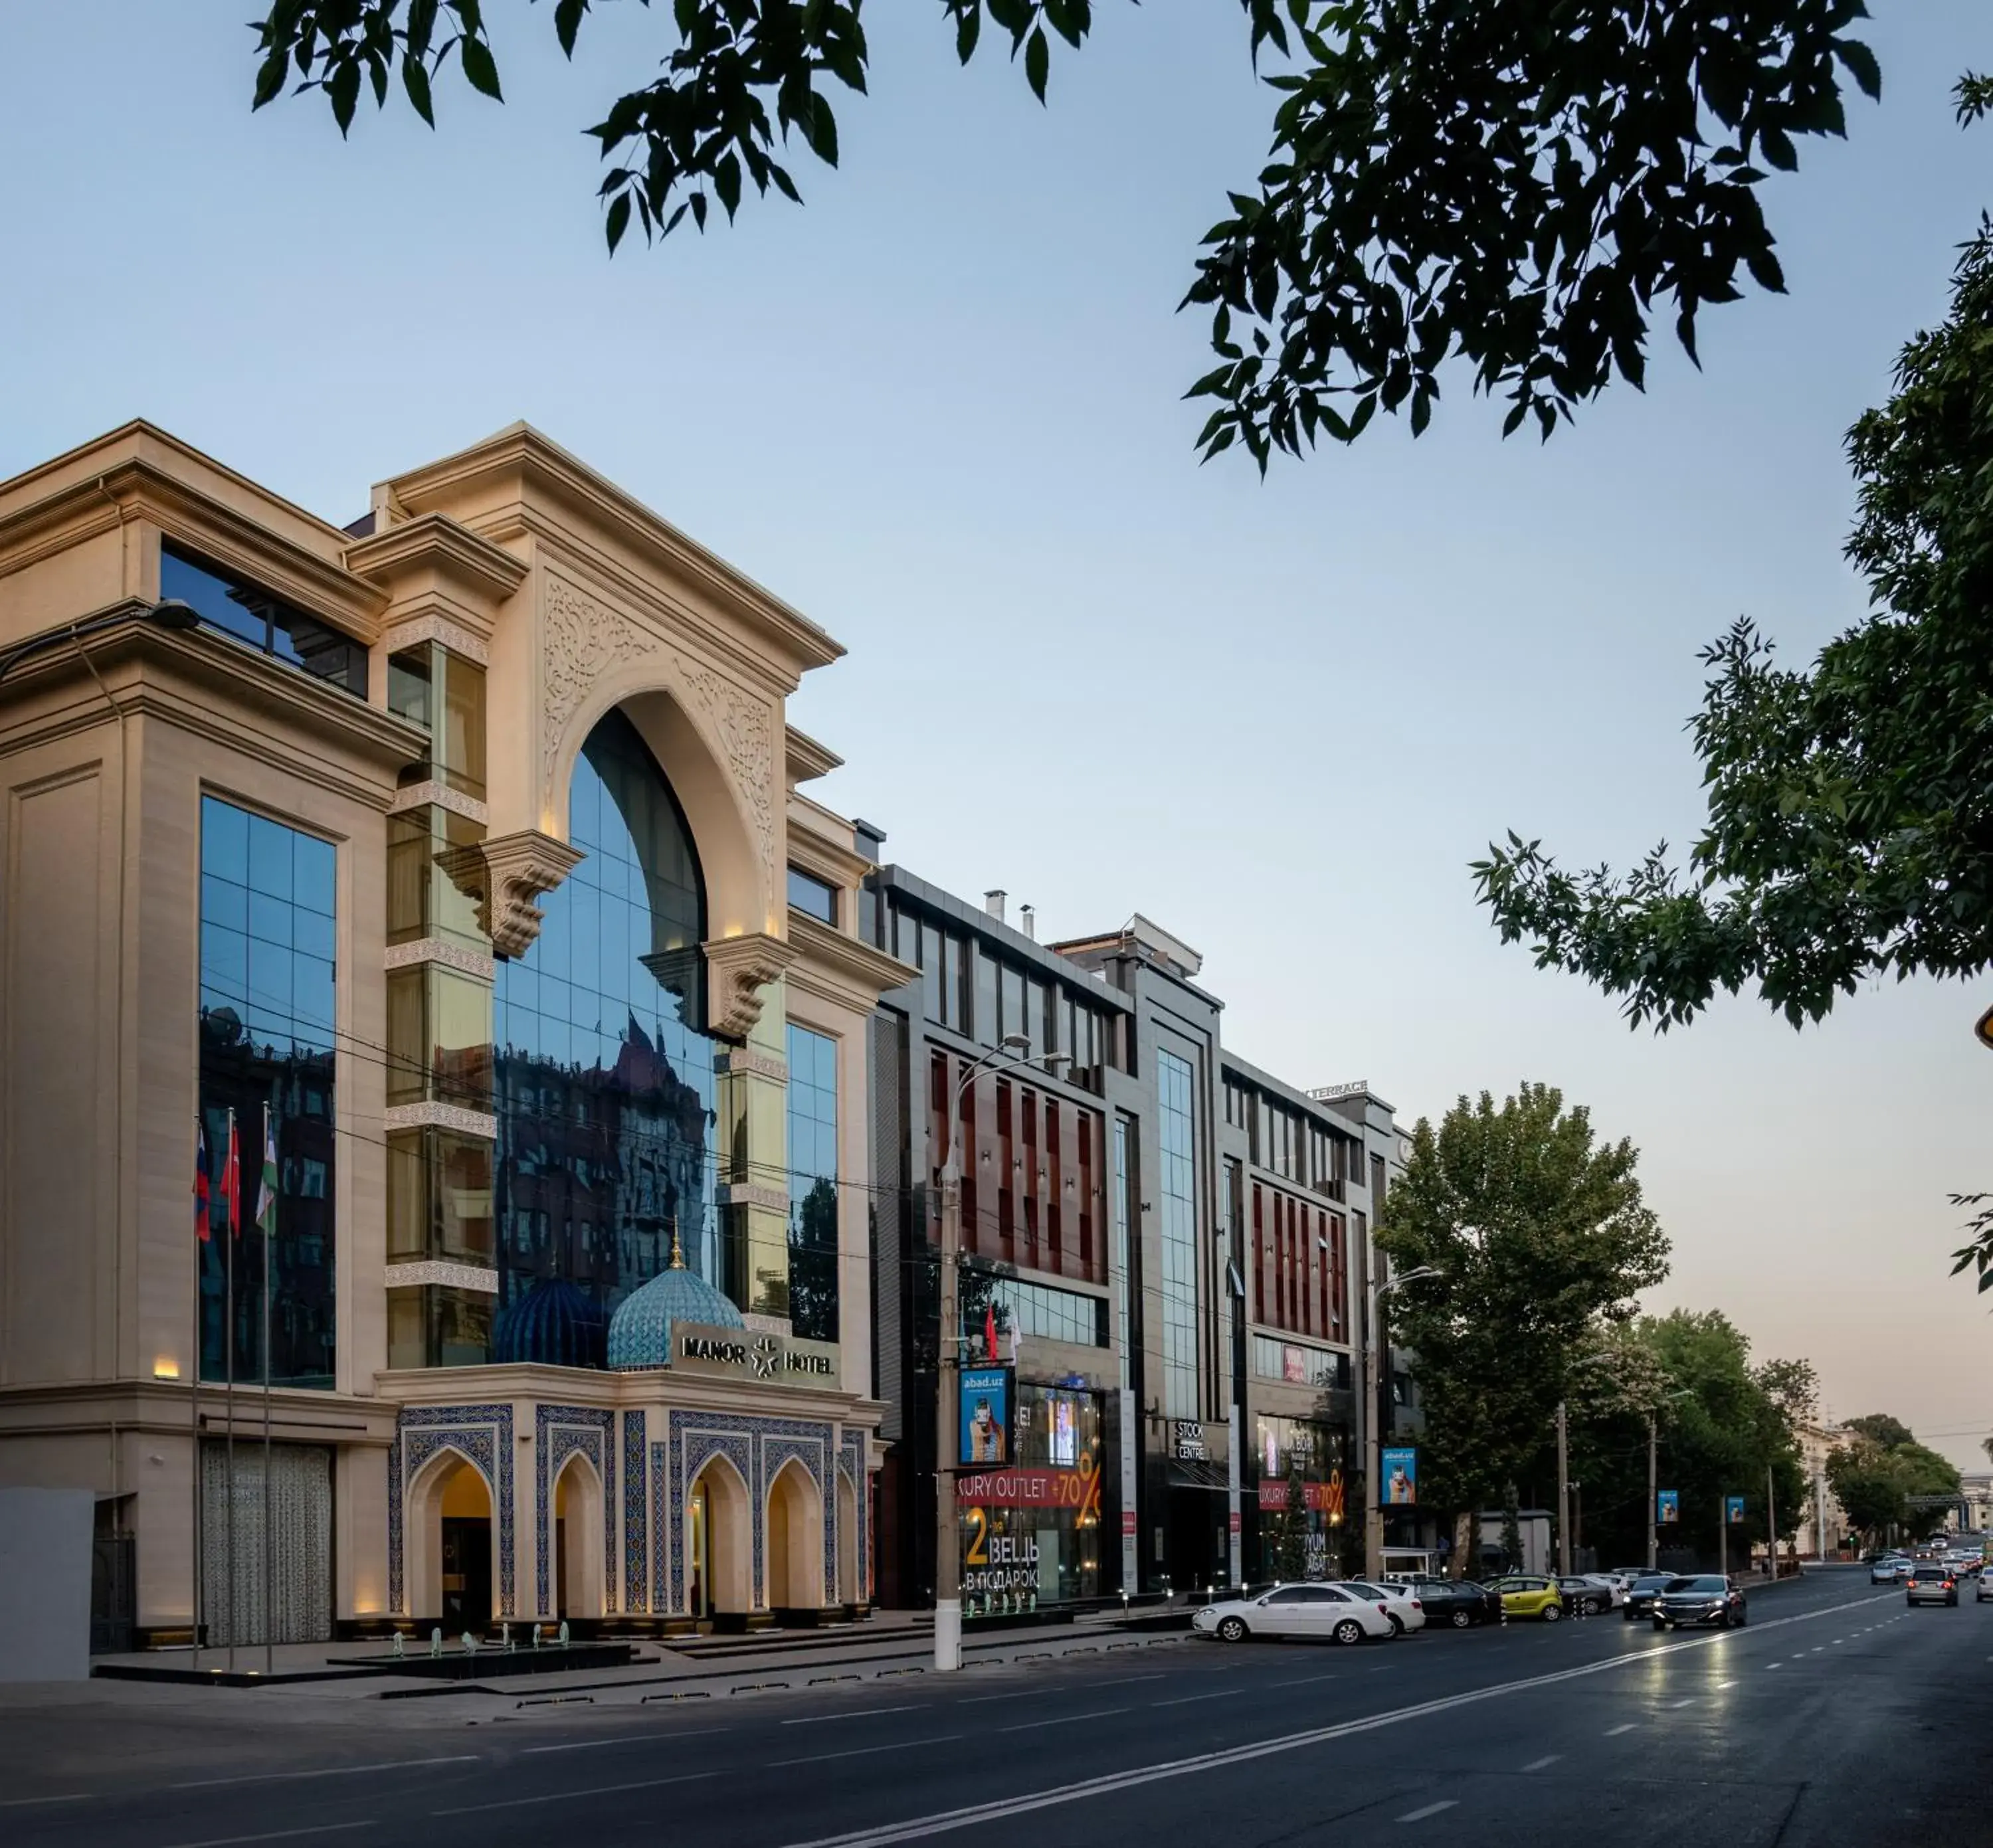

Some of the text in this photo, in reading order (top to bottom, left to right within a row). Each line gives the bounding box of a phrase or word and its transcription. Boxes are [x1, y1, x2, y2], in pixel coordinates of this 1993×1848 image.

[680, 1336, 834, 1374] MANOR HOTEL
[965, 1376, 1004, 1388] abad.uz
[1179, 1422, 1203, 1438] STOCK
[1179, 1446, 1204, 1459] CENTRE
[996, 1477, 1047, 1498] OUTLET
[966, 1507, 1040, 1568] 2 ВЕЩЬ
